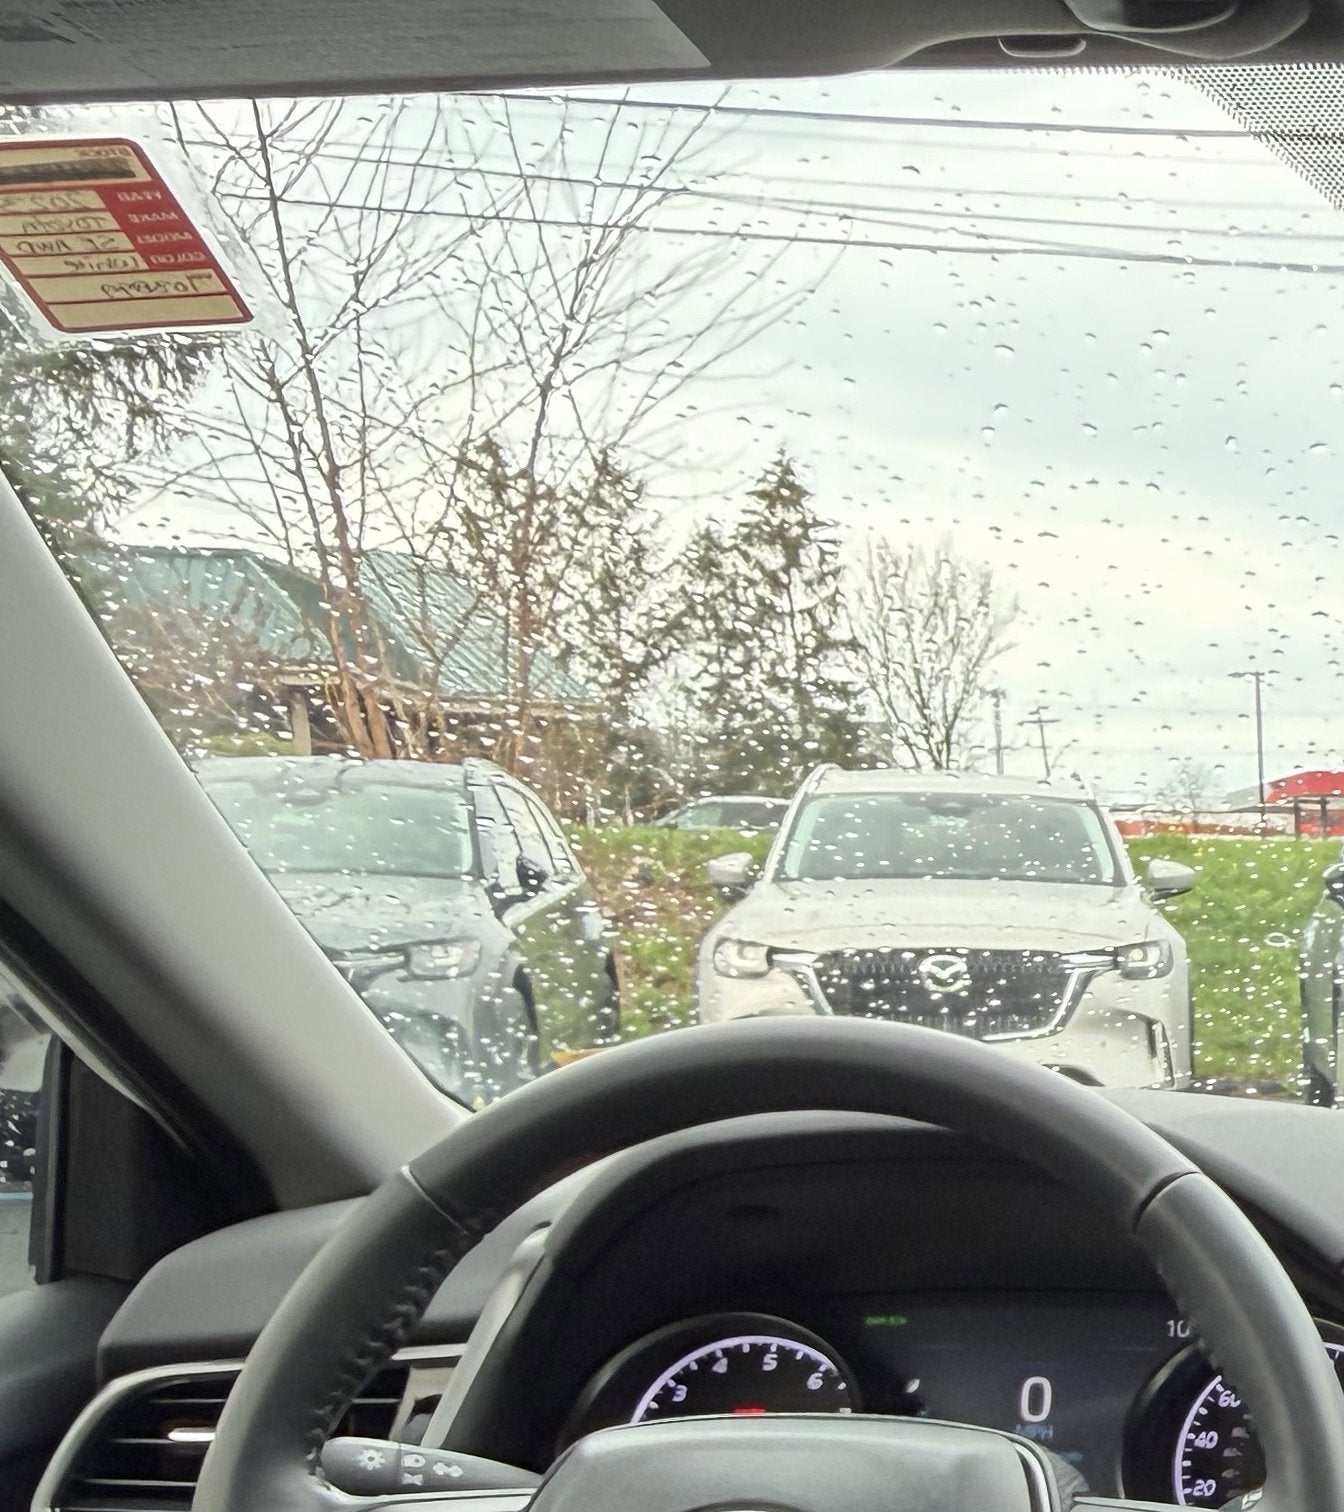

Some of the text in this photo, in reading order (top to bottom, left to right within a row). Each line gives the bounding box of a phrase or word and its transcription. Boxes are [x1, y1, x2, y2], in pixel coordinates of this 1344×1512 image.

[711, 1357, 728, 1373] 4
[762, 1353, 778, 1371] 5
[807, 1372, 823, 1390] 6
[672, 1385, 688, 1402] 3
[1021, 1376, 1052, 1422] 0
[1194, 1431, 1218, 1449] 40
[1193, 1479, 1217, 1497] 20
